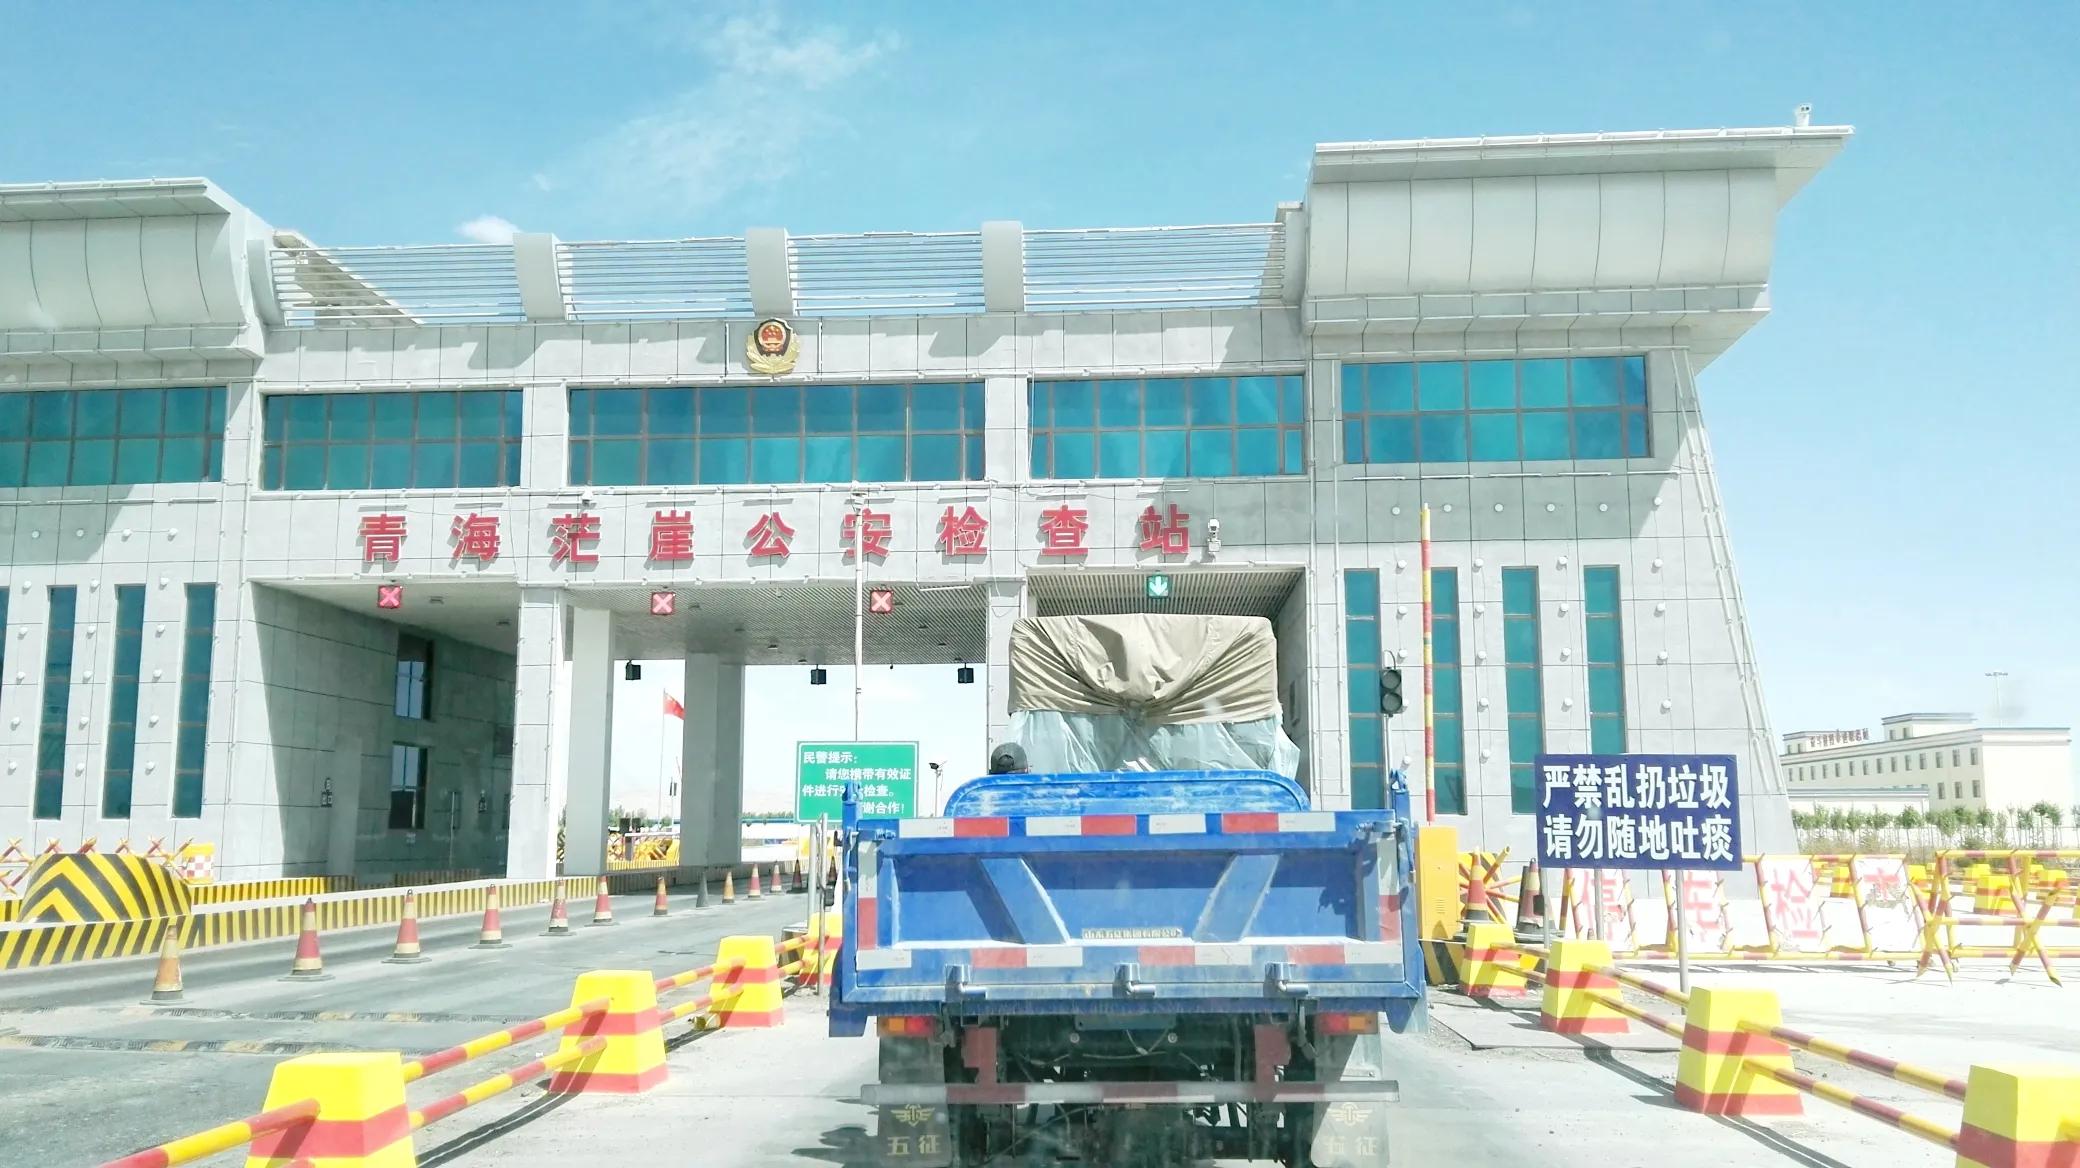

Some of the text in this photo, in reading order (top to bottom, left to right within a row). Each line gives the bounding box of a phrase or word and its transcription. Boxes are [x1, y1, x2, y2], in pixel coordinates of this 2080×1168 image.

[358, 503, 1191, 563] 青海茫崖公安检查站
[802, 784, 894, 797] 件进行检查。
[1543, 763, 1732, 809] 严禁乱扔垃圾
[1543, 813, 1734, 862] 请勿随地吐痰
[888, 1135, 941, 1155] 五征
